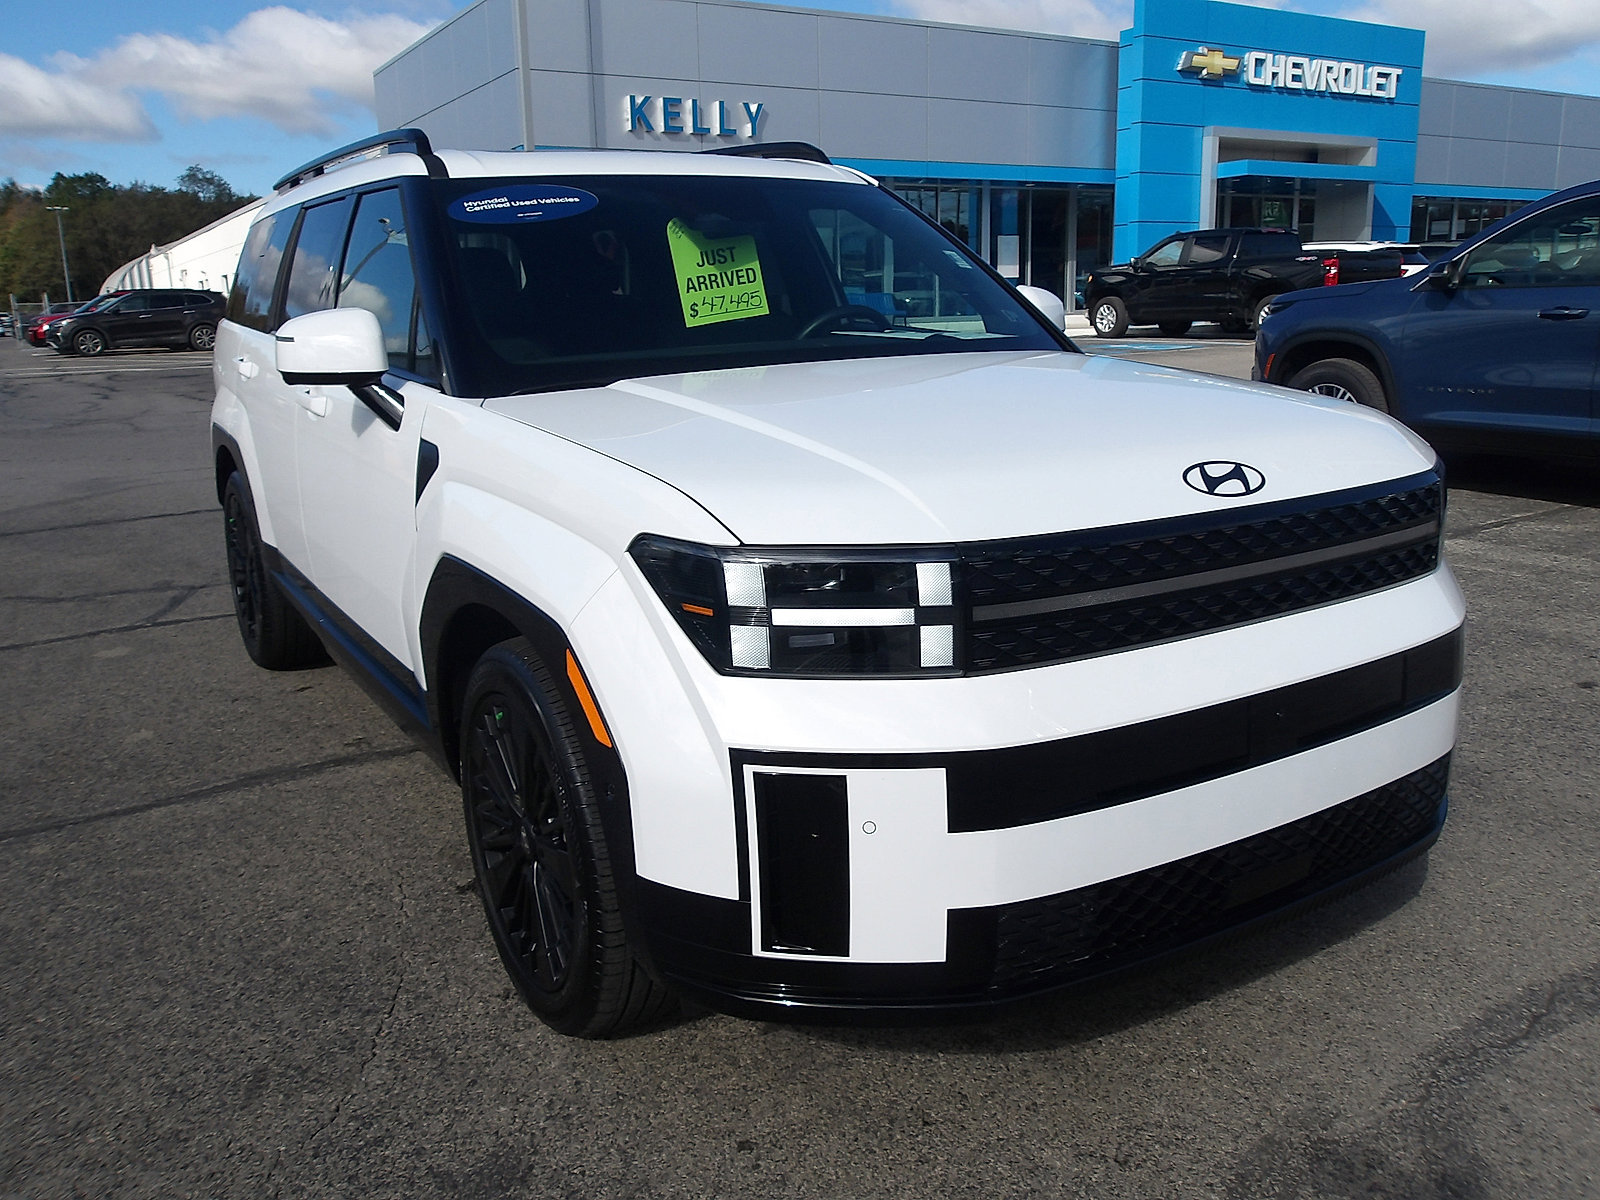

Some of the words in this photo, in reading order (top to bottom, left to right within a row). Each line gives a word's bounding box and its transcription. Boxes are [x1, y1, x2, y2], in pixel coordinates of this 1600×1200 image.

[1245, 51, 1403, 99] CHEVROLET
[624, 94, 764, 137] KELLY
[464, 197, 508, 207] Hyundai
[465, 202, 510, 212] Certified
[511, 199, 537, 207] Used
[696, 246, 737, 268] JUST
[686, 267, 757, 294] ARRIVED
